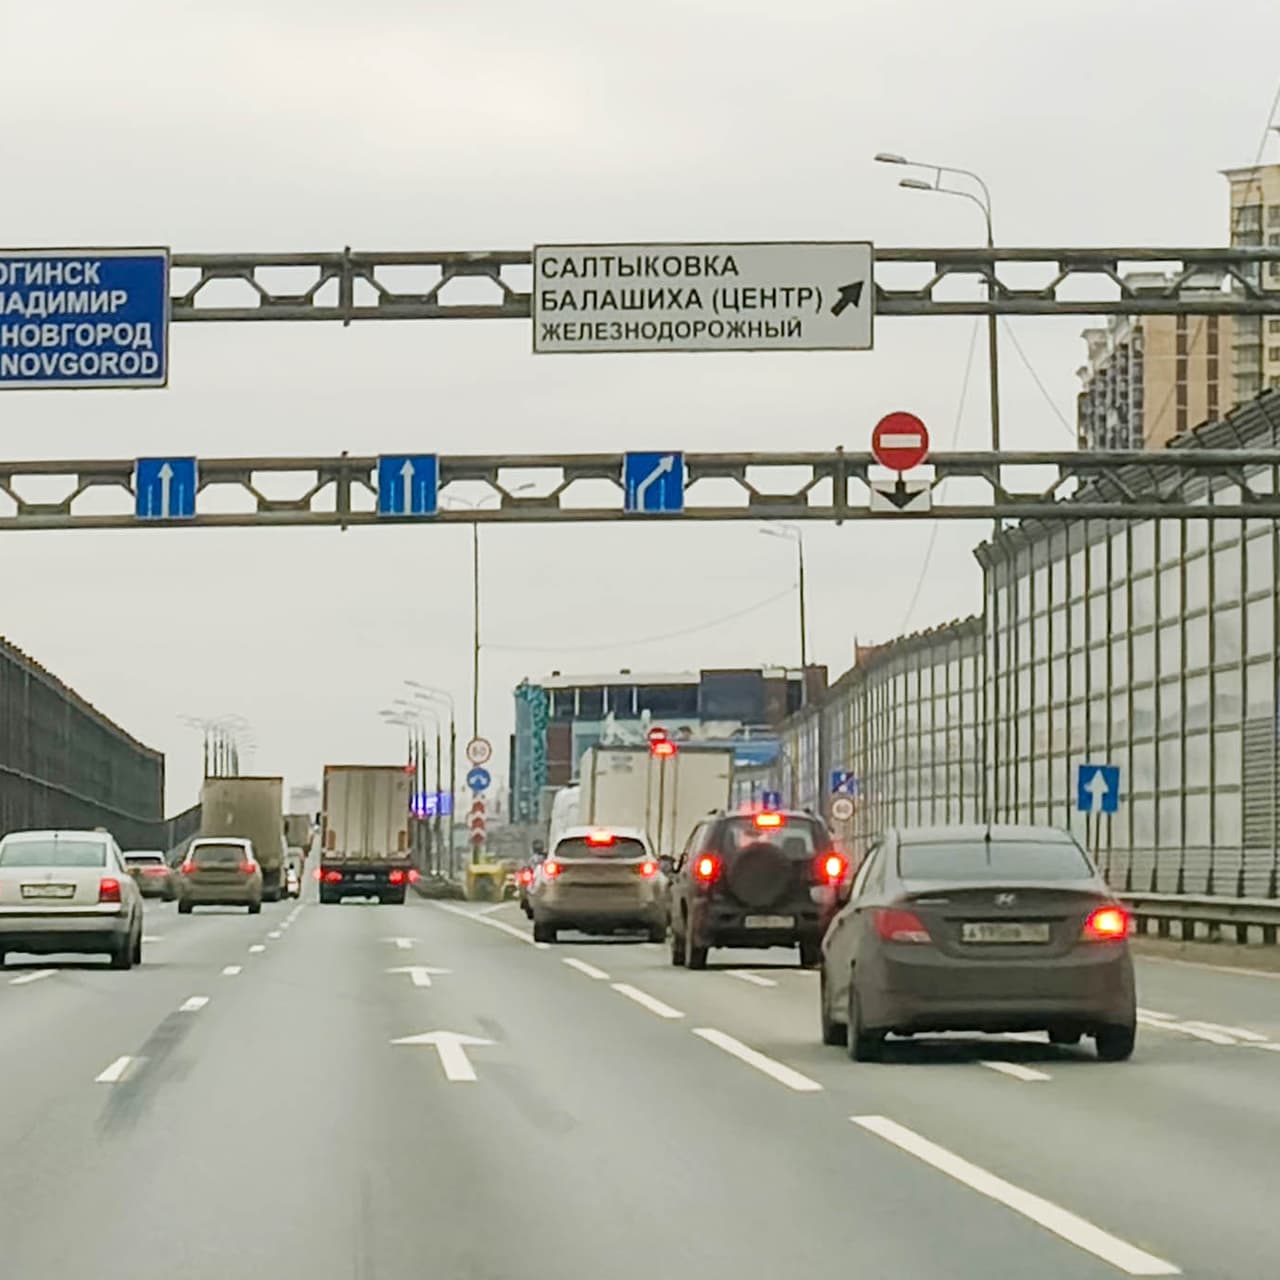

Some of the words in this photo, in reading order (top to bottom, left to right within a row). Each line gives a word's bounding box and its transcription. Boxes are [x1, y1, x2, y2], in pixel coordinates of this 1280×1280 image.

[540, 255, 739, 279] САЛТЫКОВКА
[541, 288, 703, 311] БАЛАШИХА
[712, 286, 823, 314] (ЦЕНТР)
[1, 323, 152, 350] НОВГОРОД
[541, 317, 803, 342] ЖЕЛЕЗНОДОРОЖНЫЙ
[0, 352, 159, 377] NOVGOROD
